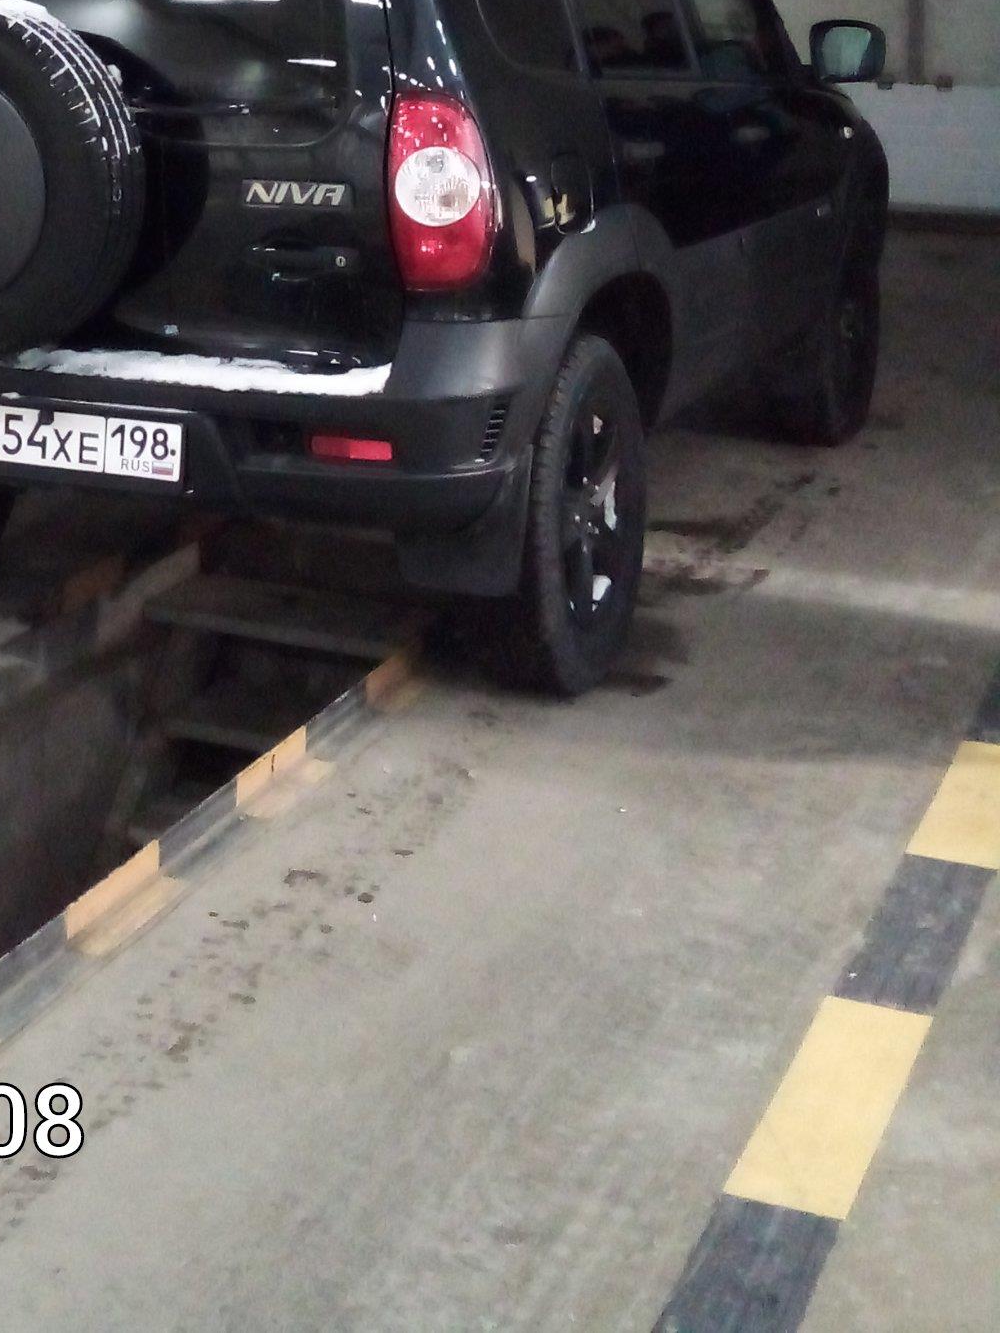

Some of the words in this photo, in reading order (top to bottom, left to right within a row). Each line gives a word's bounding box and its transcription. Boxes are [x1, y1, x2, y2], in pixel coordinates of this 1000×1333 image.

[245, 181, 346, 206] NIVA
[110, 424, 169, 460] 198
[121, 458, 151, 473] RUS
